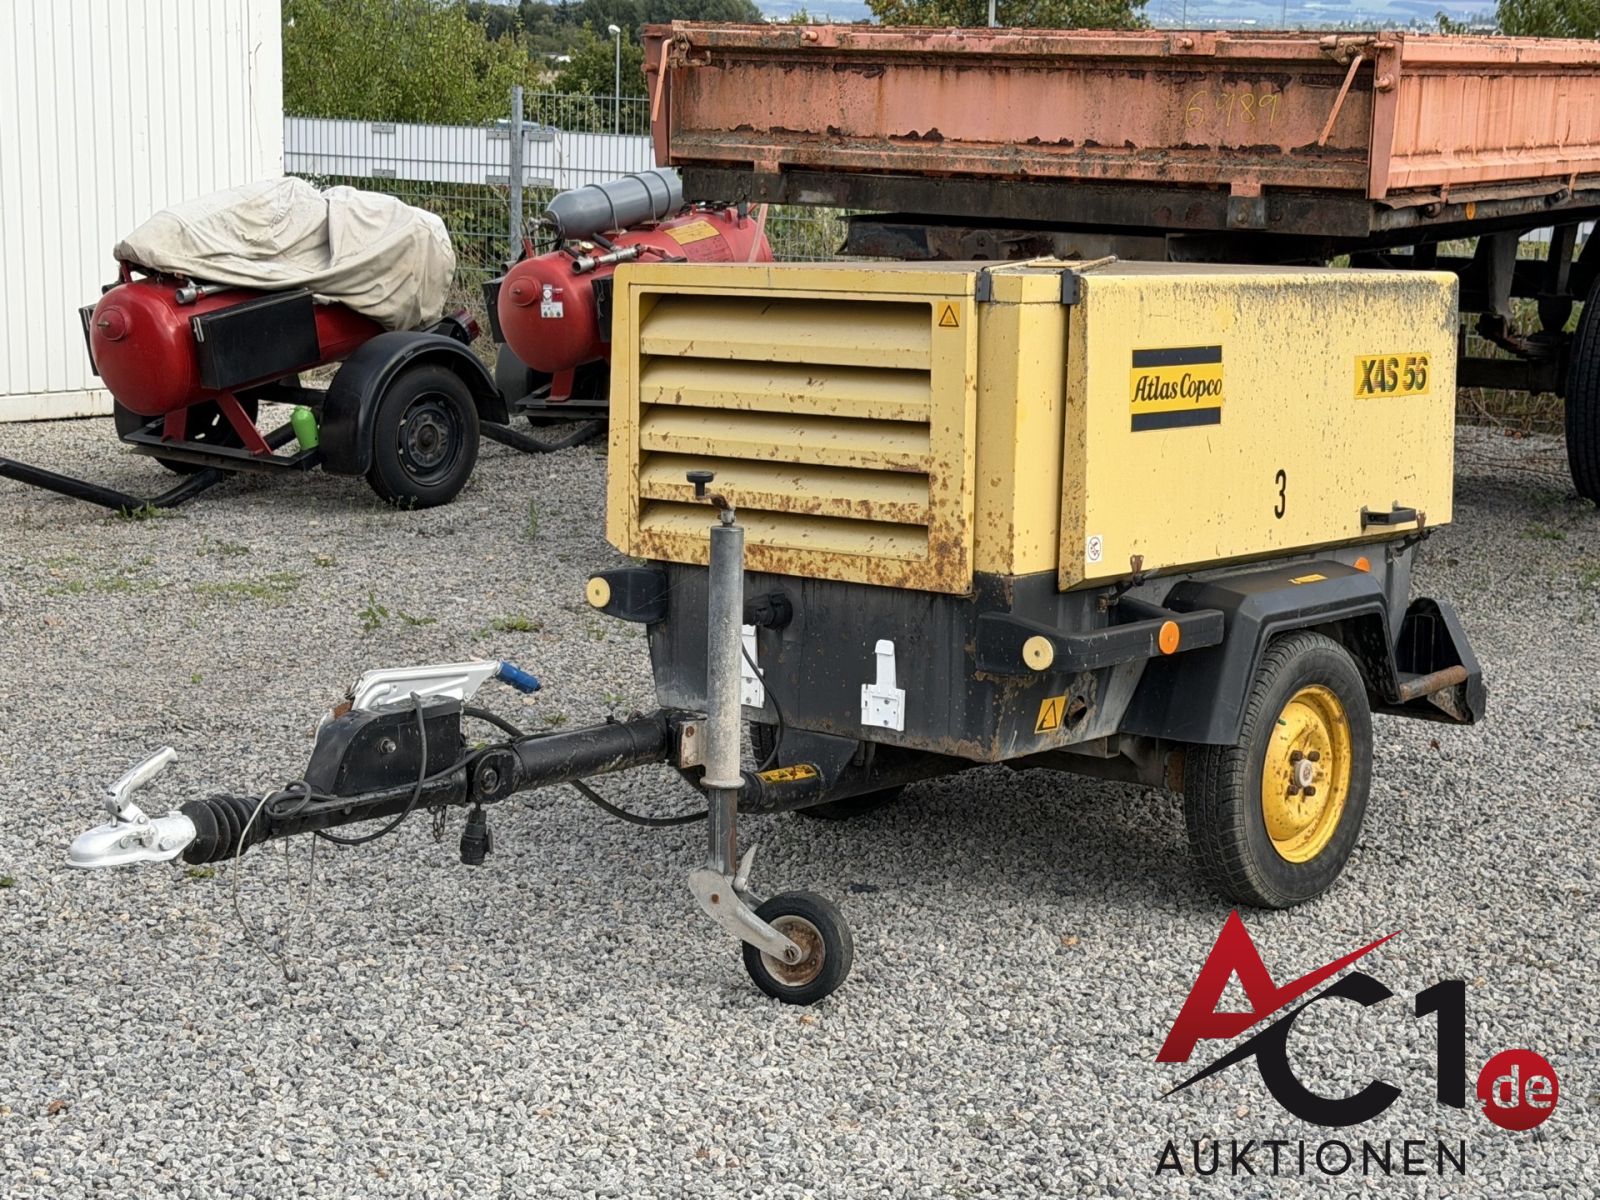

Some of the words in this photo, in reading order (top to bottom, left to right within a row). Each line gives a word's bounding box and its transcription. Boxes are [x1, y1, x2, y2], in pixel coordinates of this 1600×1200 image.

[1131, 375, 1178, 403] Atlas
[1180, 372, 1223, 403] Copco
[1356, 358, 1399, 396] XAS
[1402, 356, 1428, 391] 56
[1274, 469, 1287, 519] 3
